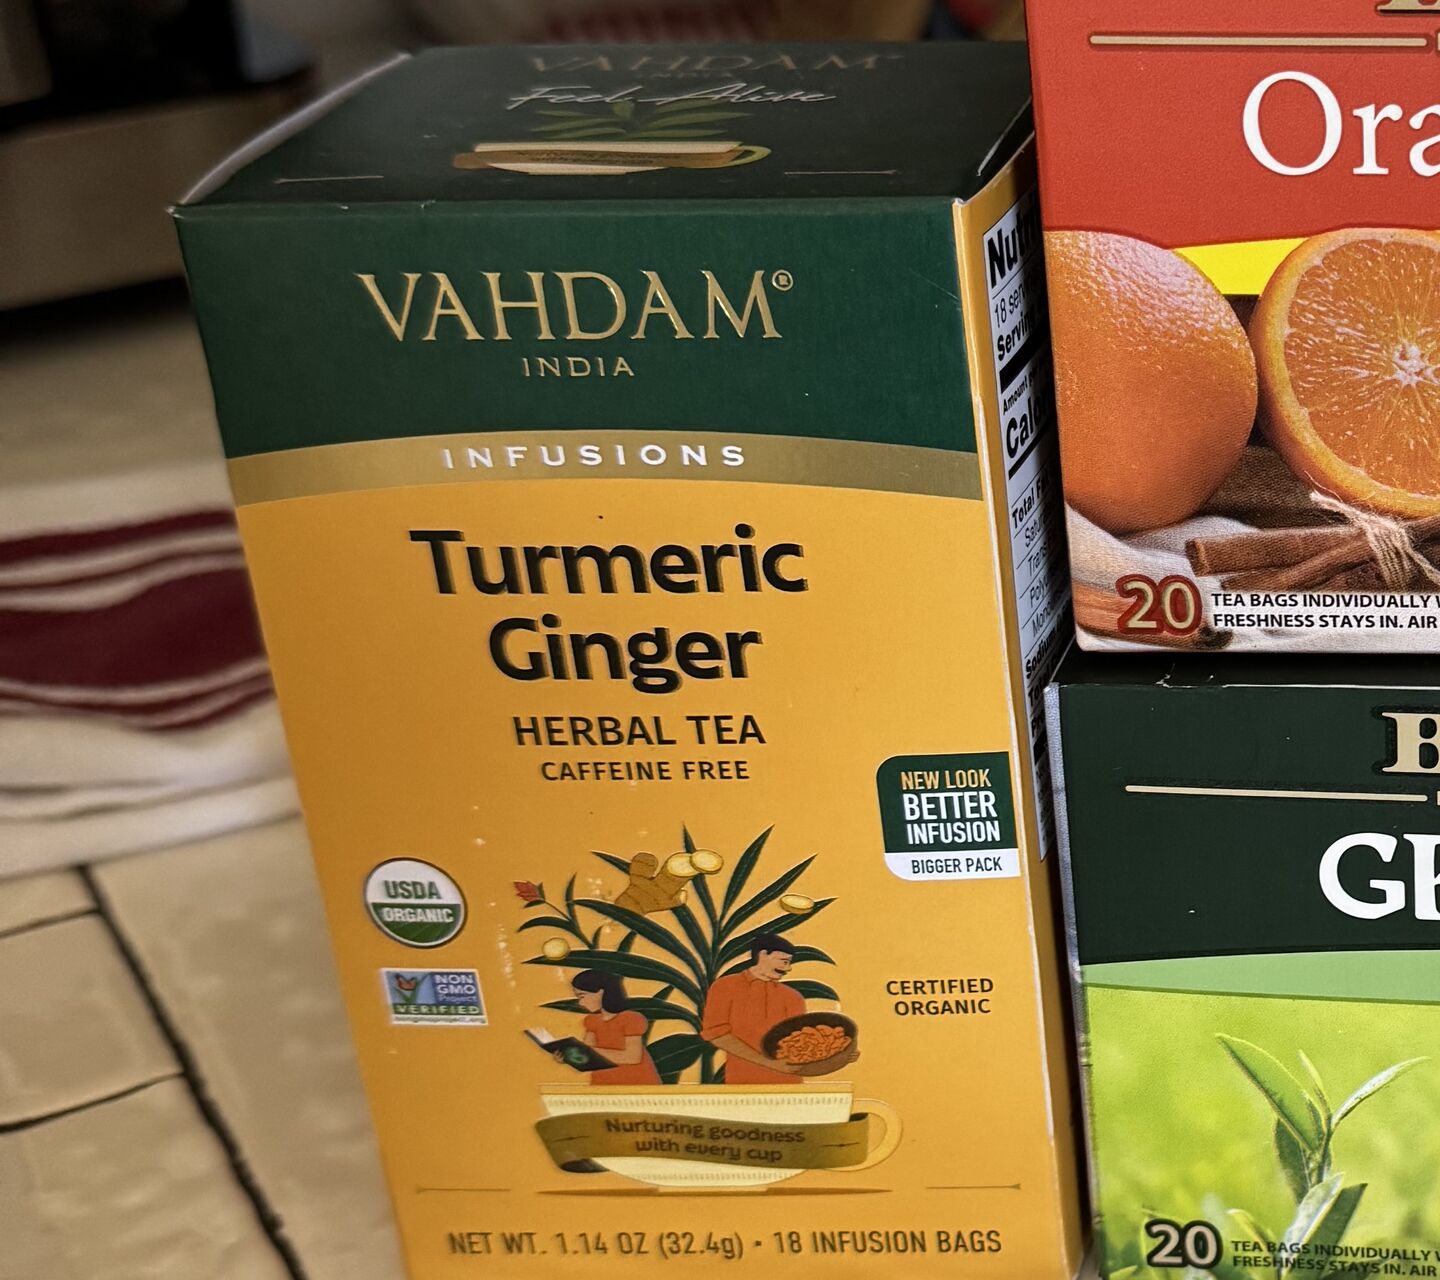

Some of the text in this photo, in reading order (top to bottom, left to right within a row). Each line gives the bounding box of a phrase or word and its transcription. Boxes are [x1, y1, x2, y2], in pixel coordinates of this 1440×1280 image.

[506, 82, 838, 111] Feel Alive
[522, 356, 635, 377] INDIA
[442, 444, 746, 469] INFUSIONS
[408, 523, 809, 595] Turmeric
[1118, 577, 1199, 632] 20
[1211, 592, 1246, 608] TEA
[1249, 593, 1299, 609] BAGS
[1302, 593, 1431, 609] INDIVIDUALLY
[1213, 613, 1315, 629] FRESHNESS
[1318, 614, 1376, 629] STAYS
[1379, 614, 1403, 629] IN.
[1407, 615, 1436, 630] AIR
[488, 613, 764, 695] Ginger
[512, 715, 767, 747] HERBAL TEA
[541, 760, 751, 782] CAFFEINE FREE
[901, 768, 992, 791] NEW LOOK
[902, 790, 998, 821] BETTER
[906, 820, 1001, 845] INFUSION
[911, 856, 1003, 874] BIGGER PACK
[384, 880, 442, 899] USDA
[382, 907, 454, 923] ORGANIC
[435, 974, 474, 984] NON
[437, 984, 476, 995] GMO
[886, 977, 994, 996] CERTIFIED
[396, 1005, 480, 1015] VERIFIED
[894, 998, 991, 1016] ORGANIC
[606, 1117, 806, 1145] Nurturing goodness
[635, 1136, 784, 1164] with every cup
[449, 1229, 1003, 1261] NET WT. 1.14 OZ (32.4g) 18 INFUSION BAGS
[1145, 1220, 1222, 1269] 20
[1231, 1240, 1263, 1254] TEA
[1267, 1241, 1311, 1255] BAGS
[1314, 1243, 1431, 1262] INDIVIDUALLY
[1232, 1255, 1325, 1271] FRESHNESS
[1328, 1260, 1380, 1275] STAYS
[1383, 1262, 1406, 1276] IN.
[1409, 1264, 1437, 1278] AIR
